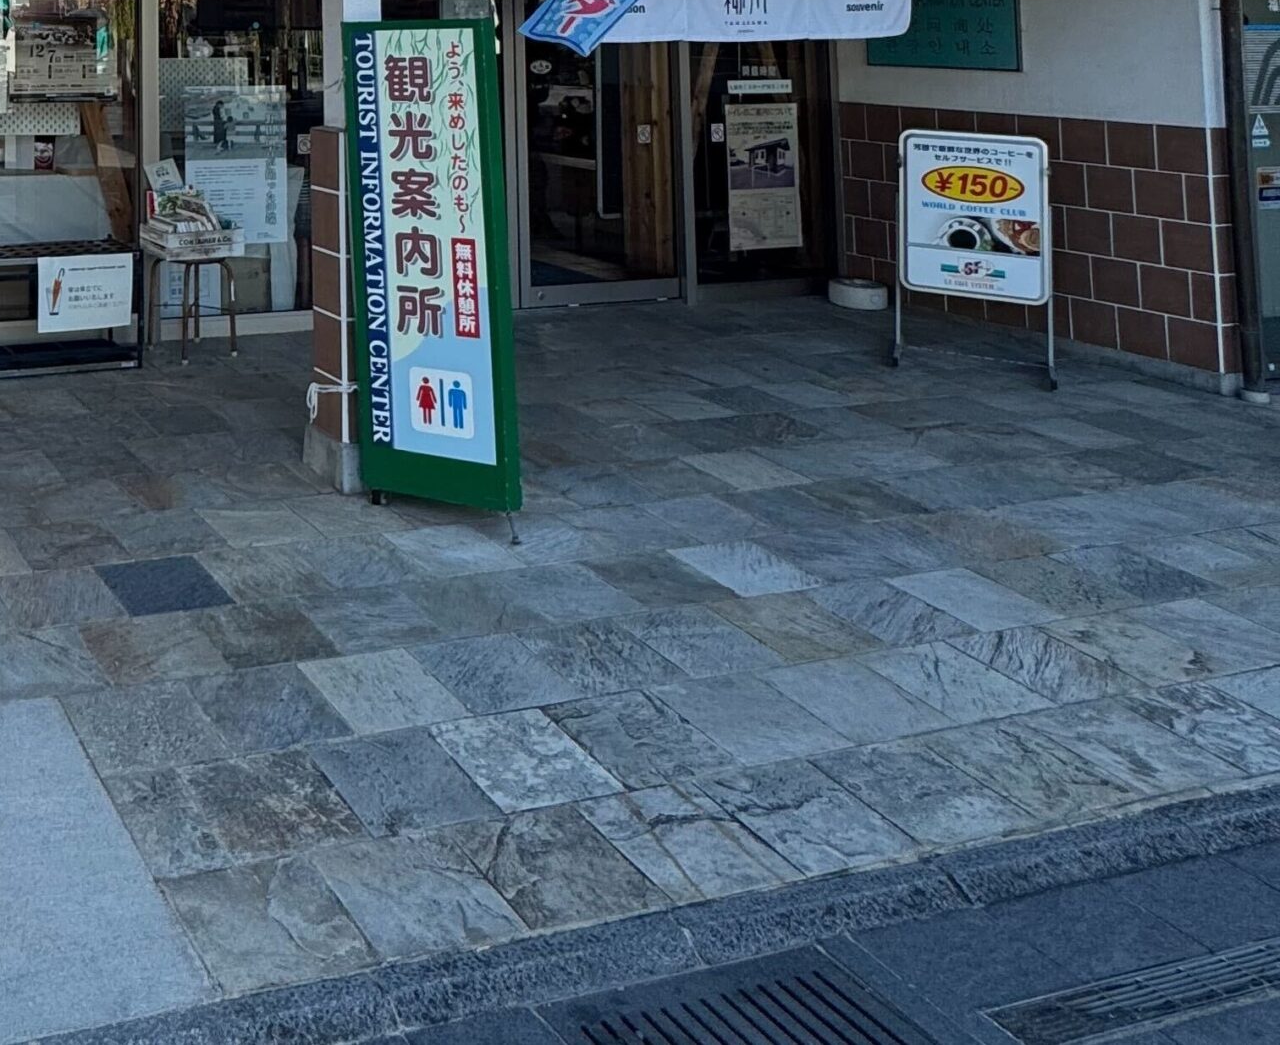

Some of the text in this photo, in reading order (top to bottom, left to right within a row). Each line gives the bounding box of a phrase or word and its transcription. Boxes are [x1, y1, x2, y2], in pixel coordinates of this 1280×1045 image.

[846, 2, 884, 12] souvenir
[354, 34, 391, 443] TOURIST INFORMATION CENTER
[384, 54, 447, 339] 観光案内所
[921, 201, 1027, 217] WORLD COFFEE CLUB
[454, 242, 476, 334] 無料休憩所
